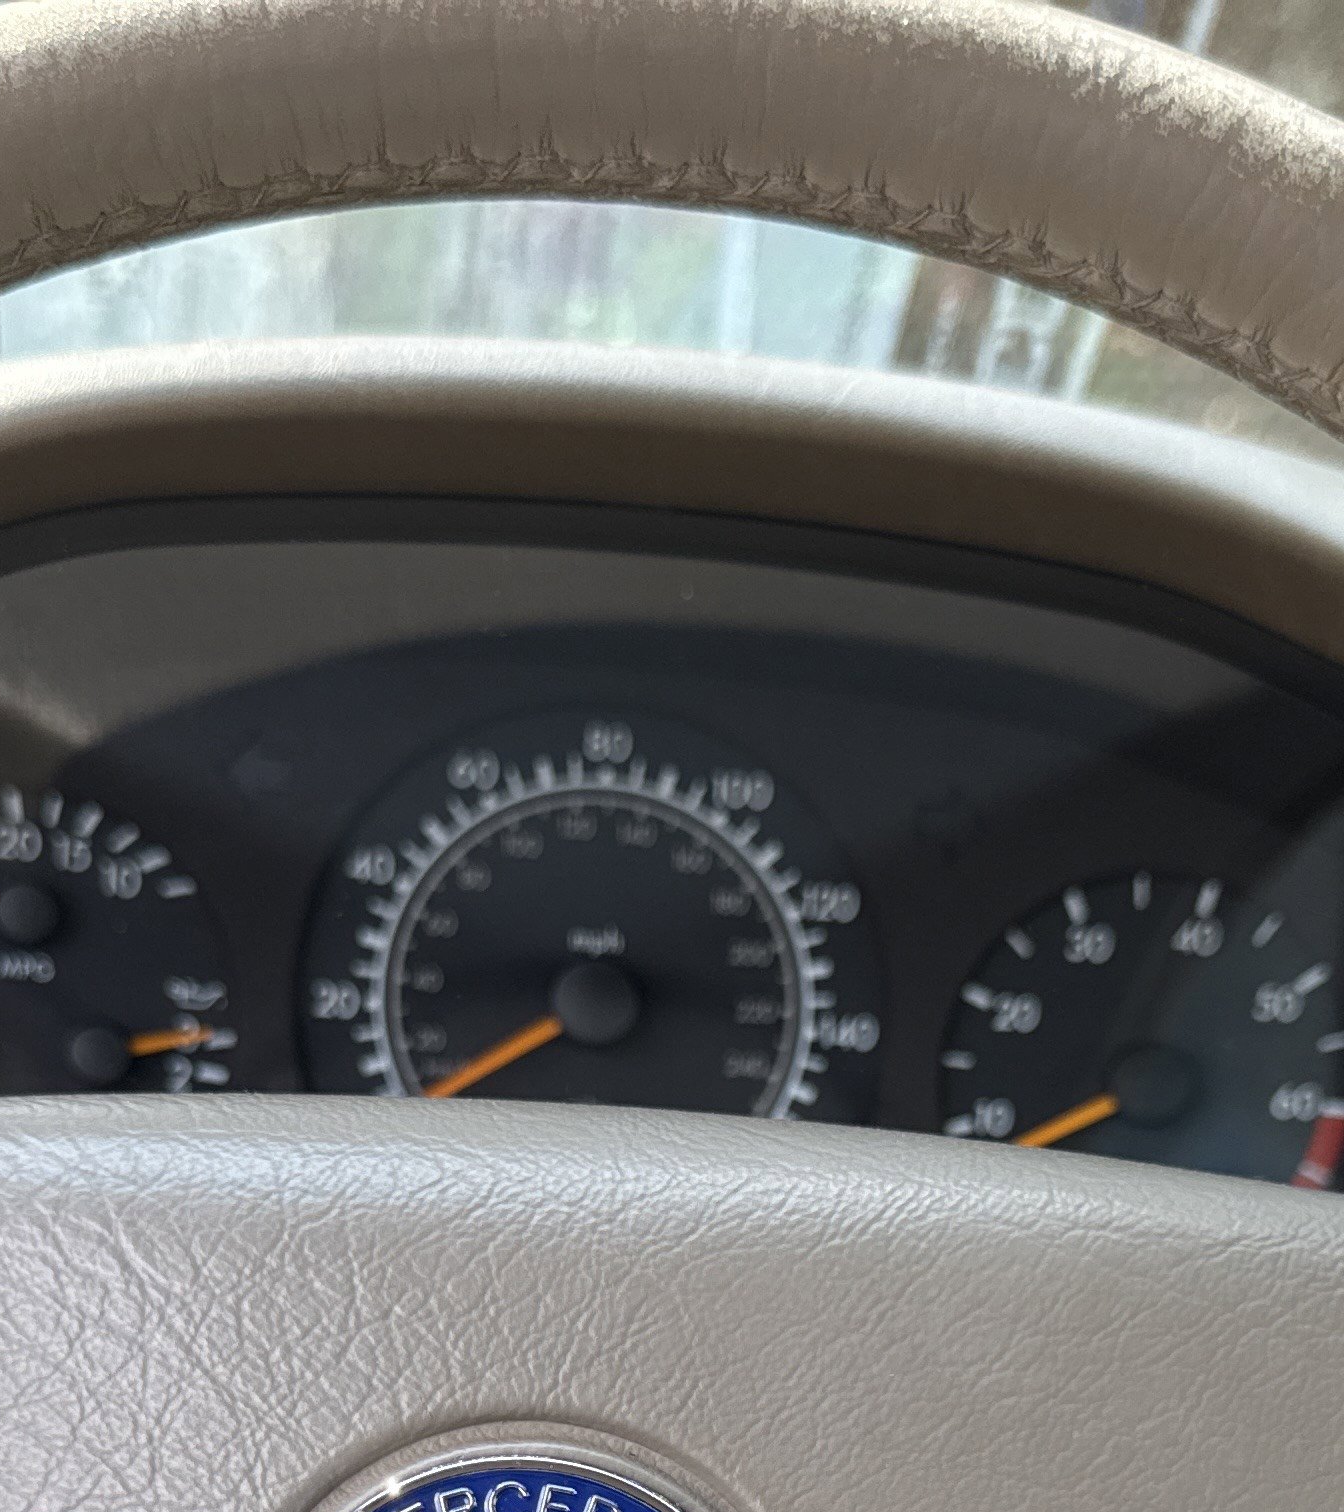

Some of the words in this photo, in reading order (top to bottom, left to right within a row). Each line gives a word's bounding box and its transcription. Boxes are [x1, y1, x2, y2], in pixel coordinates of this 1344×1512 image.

[583, 719, 633, 763] 80
[446, 748, 500, 791] 60
[711, 767, 774, 812] 100
[53, 831, 92, 873] 15
[344, 844, 396, 886] 40
[98, 856, 142, 899] 10
[802, 883, 861, 924] 120
[1064, 922, 1116, 965] 30
[1171, 916, 1224, 958] 40
[309, 977, 361, 1020] 20
[991, 992, 1042, 1034] 20
[1252, 982, 1305, 1024] 50
[818, 1010, 880, 1053] 140
[973, 1097, 1016, 1138] 10
[1270, 1082, 1322, 1122] 60
